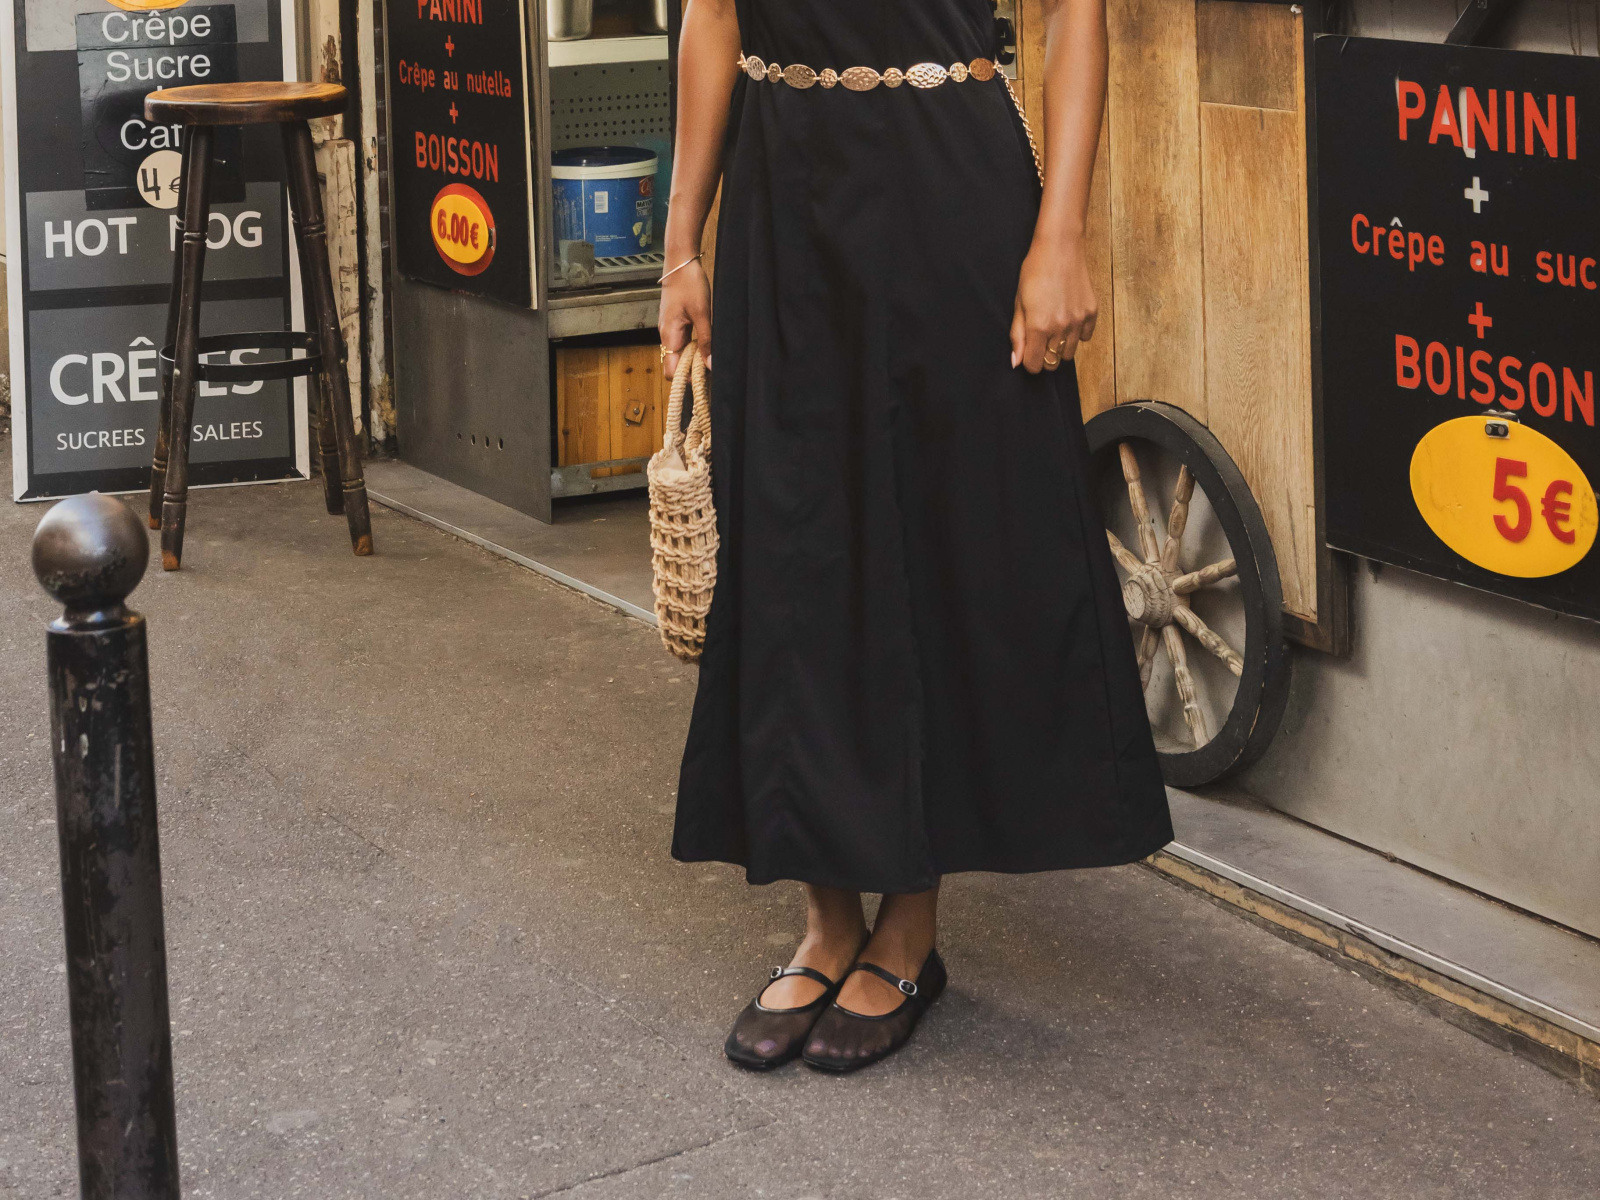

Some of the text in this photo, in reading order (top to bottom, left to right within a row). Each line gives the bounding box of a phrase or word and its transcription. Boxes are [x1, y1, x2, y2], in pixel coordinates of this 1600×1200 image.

[102, 10, 212, 46] Crêpe
[106, 51, 211, 83] Sucre
[399, 59, 512, 98] Crêpe au nutella
[120, 119, 183, 151] Caf
[1398, 80, 1577, 160] PANINI
[415, 131, 499, 183] BOISSON
[44, 211, 263, 259] HOT OG
[437, 208, 479, 250] 6.00€
[1351, 213, 1445, 272] Crêpe
[1470, 240, 1509, 277] au
[49, 336, 264, 405] CRÊES
[1395, 334, 1595, 427] BOISSON
[56, 421, 263, 451] SUCREES SALEES
[1492, 456, 1576, 544] 5€
